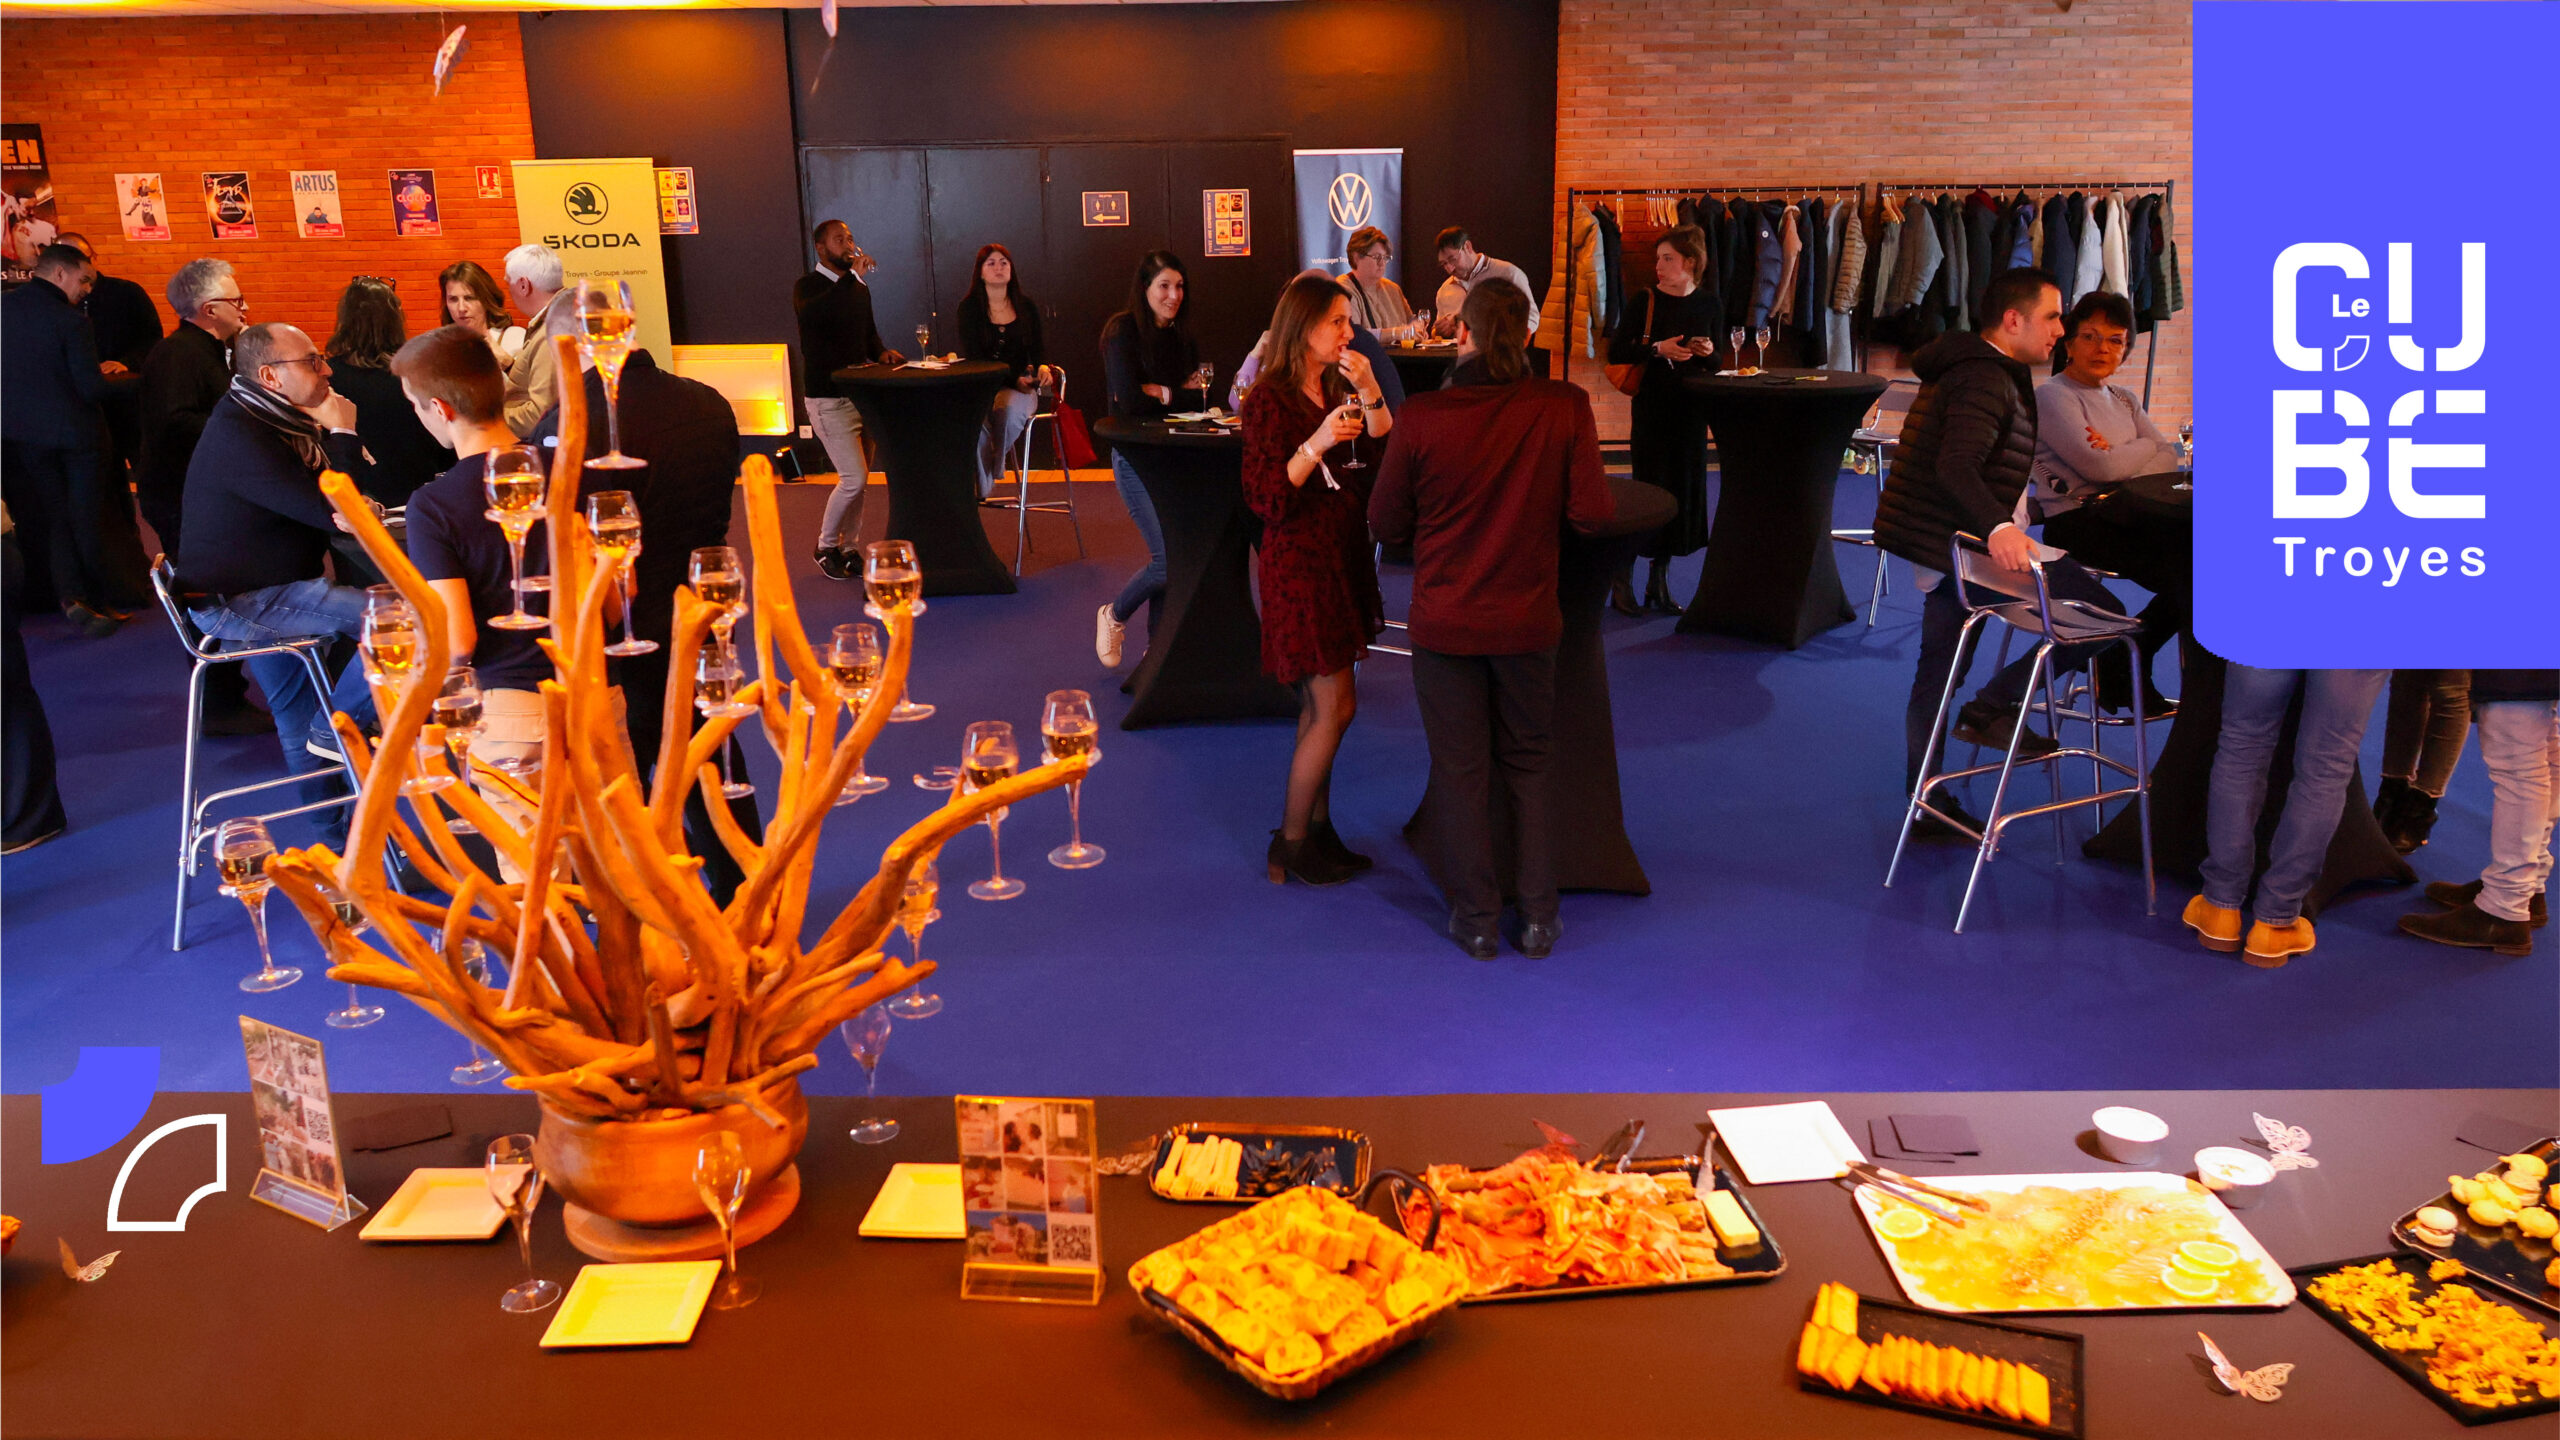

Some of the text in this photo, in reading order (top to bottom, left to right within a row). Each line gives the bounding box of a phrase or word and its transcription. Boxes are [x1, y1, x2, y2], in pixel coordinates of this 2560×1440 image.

[295, 174, 335, 191] ARTUS
[565, 270, 588, 278] Troyes
[594, 269, 620, 277] Groupe
